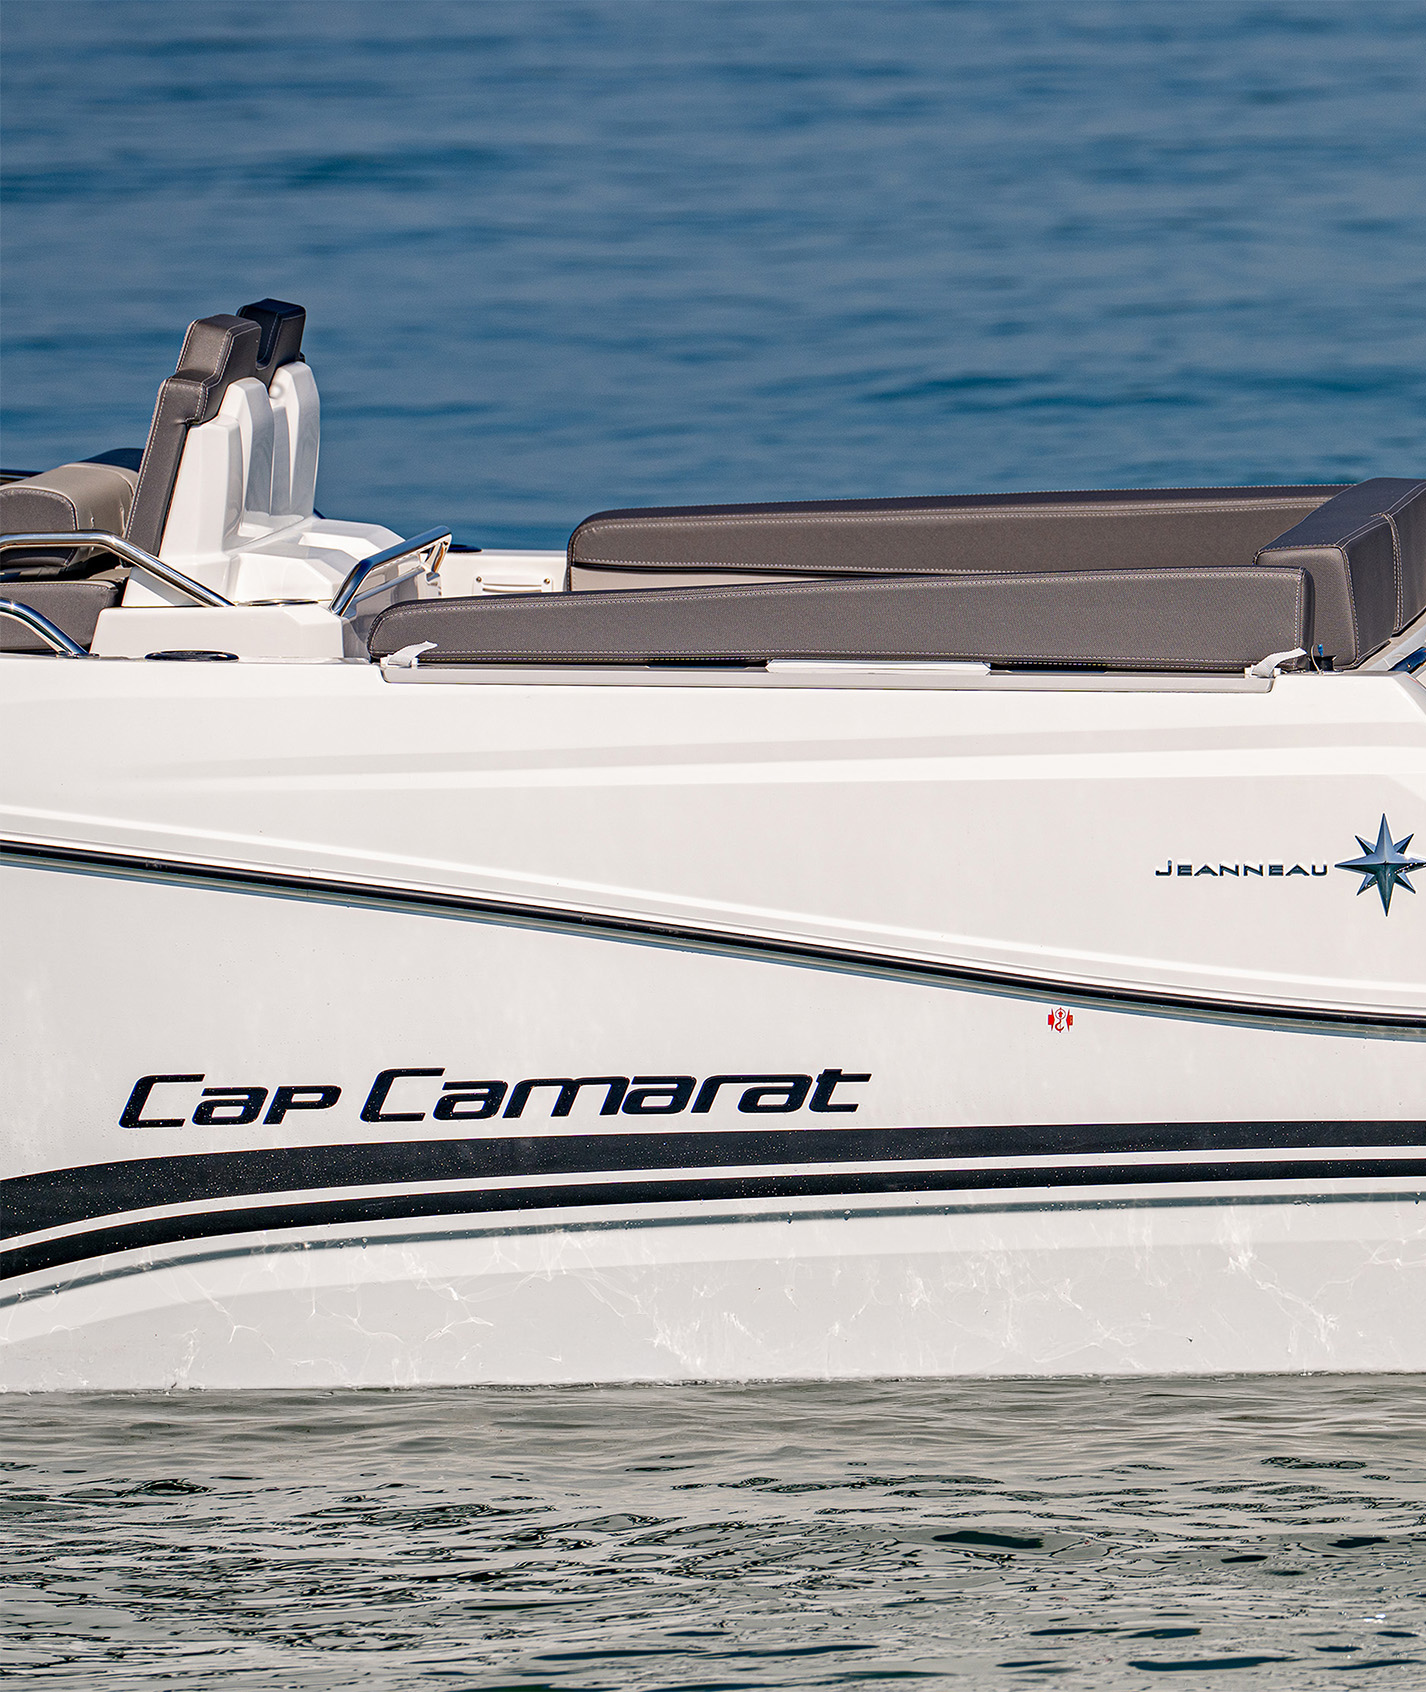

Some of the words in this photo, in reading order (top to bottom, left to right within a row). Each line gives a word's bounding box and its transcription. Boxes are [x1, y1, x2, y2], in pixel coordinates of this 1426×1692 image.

[1155, 857, 1328, 877] JEANNEAU
[118, 1073, 342, 1129] Cap
[359, 1067, 873, 1123] Camarat
